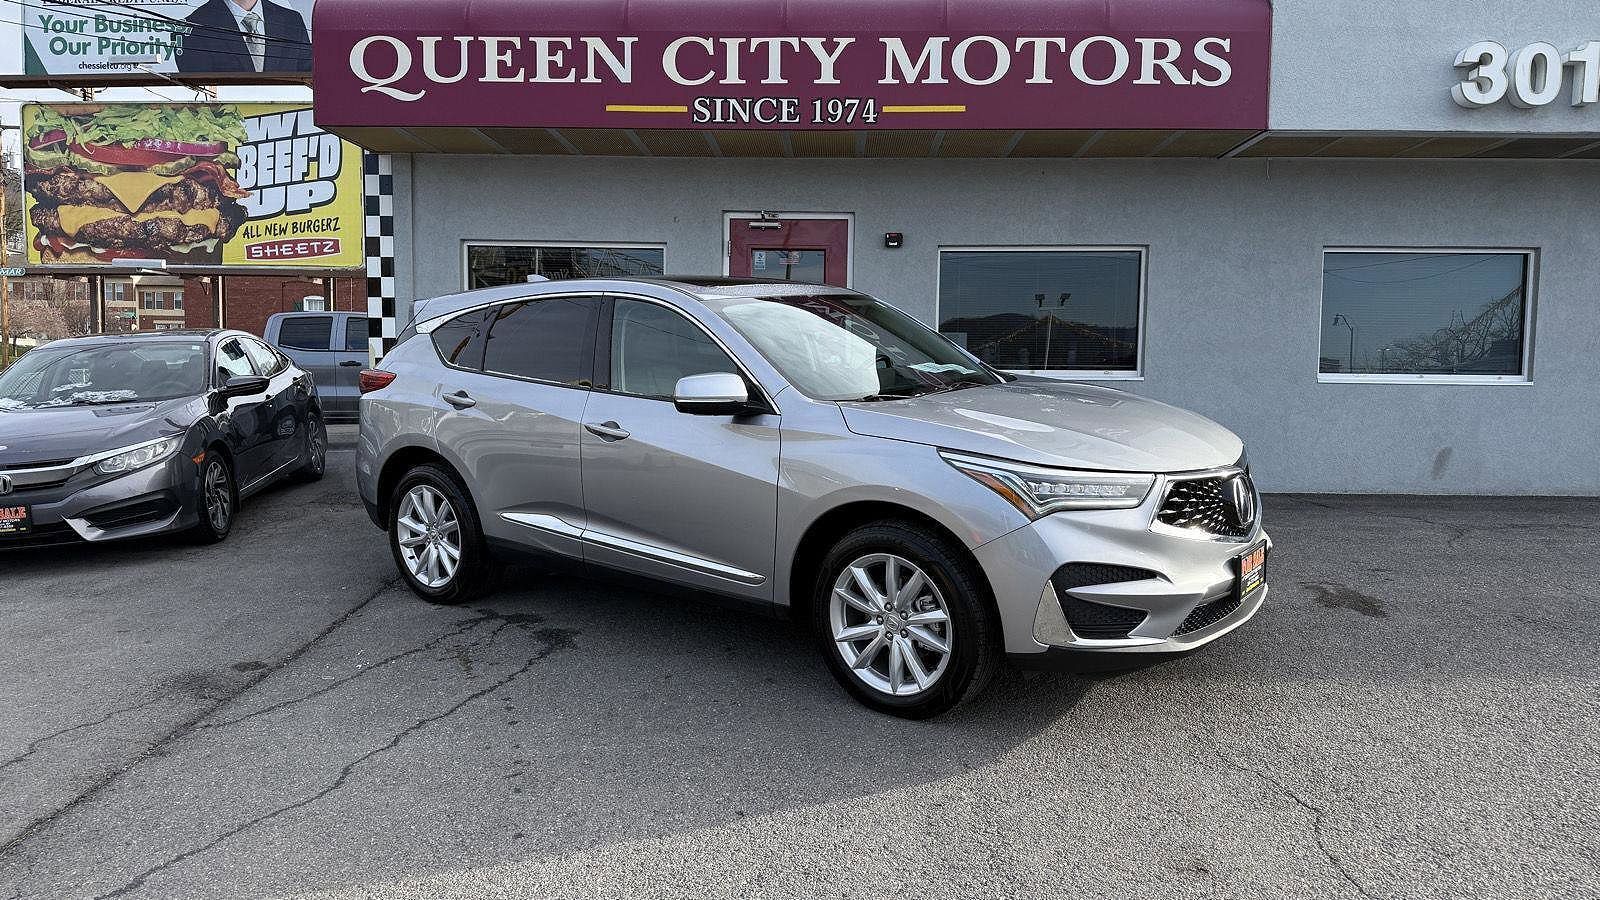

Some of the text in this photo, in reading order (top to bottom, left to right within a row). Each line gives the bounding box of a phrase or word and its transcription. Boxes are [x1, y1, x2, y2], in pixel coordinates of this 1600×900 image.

[38, 14, 88, 34] Your
[48, 34, 184, 60] Our Priority!
[349, 35, 1232, 102] QUEEN CITY MOTORS
[1451, 40, 1600, 109] 301
[692, 96, 878, 124] SINCE 1974
[235, 133, 341, 190] BEEF'D
[236, 180, 336, 218] UP
[242, 216, 341, 240] ALL NEW BURGERZ
[251, 240, 335, 259] SHEETZ
